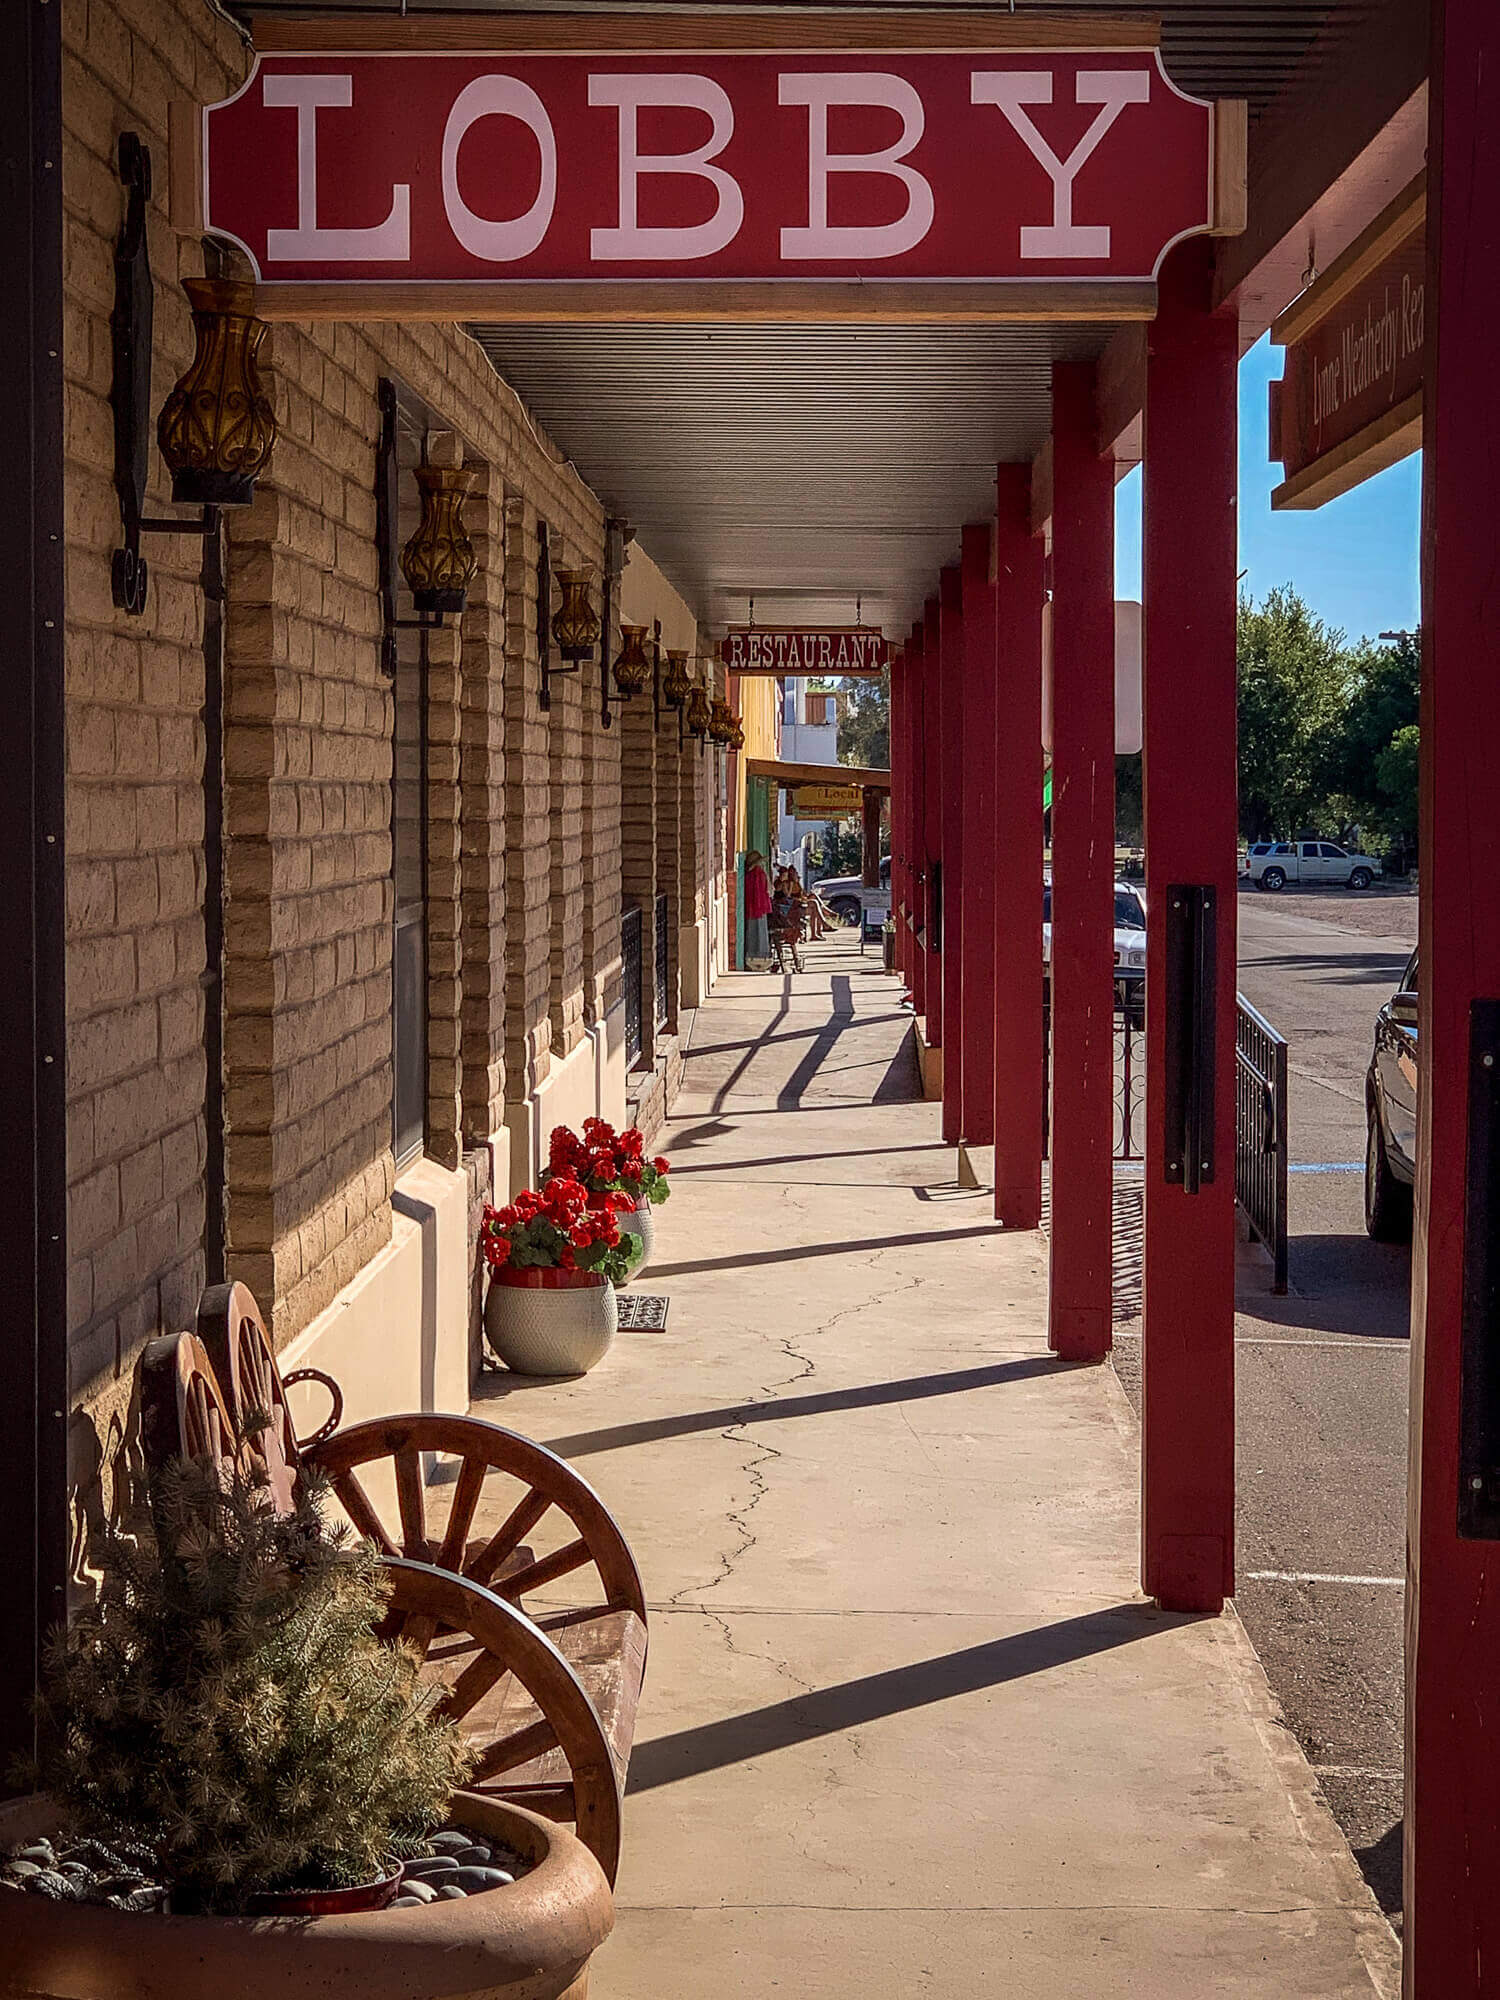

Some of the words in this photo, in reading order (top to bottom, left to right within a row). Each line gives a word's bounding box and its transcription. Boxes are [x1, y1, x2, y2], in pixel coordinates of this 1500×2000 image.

[263, 70, 1149, 262] LOBBY
[1313, 355, 1340, 453] Lynne
[1342, 286, 1400, 403] Weatherby
[729, 634, 881, 669] RESTAURANT
